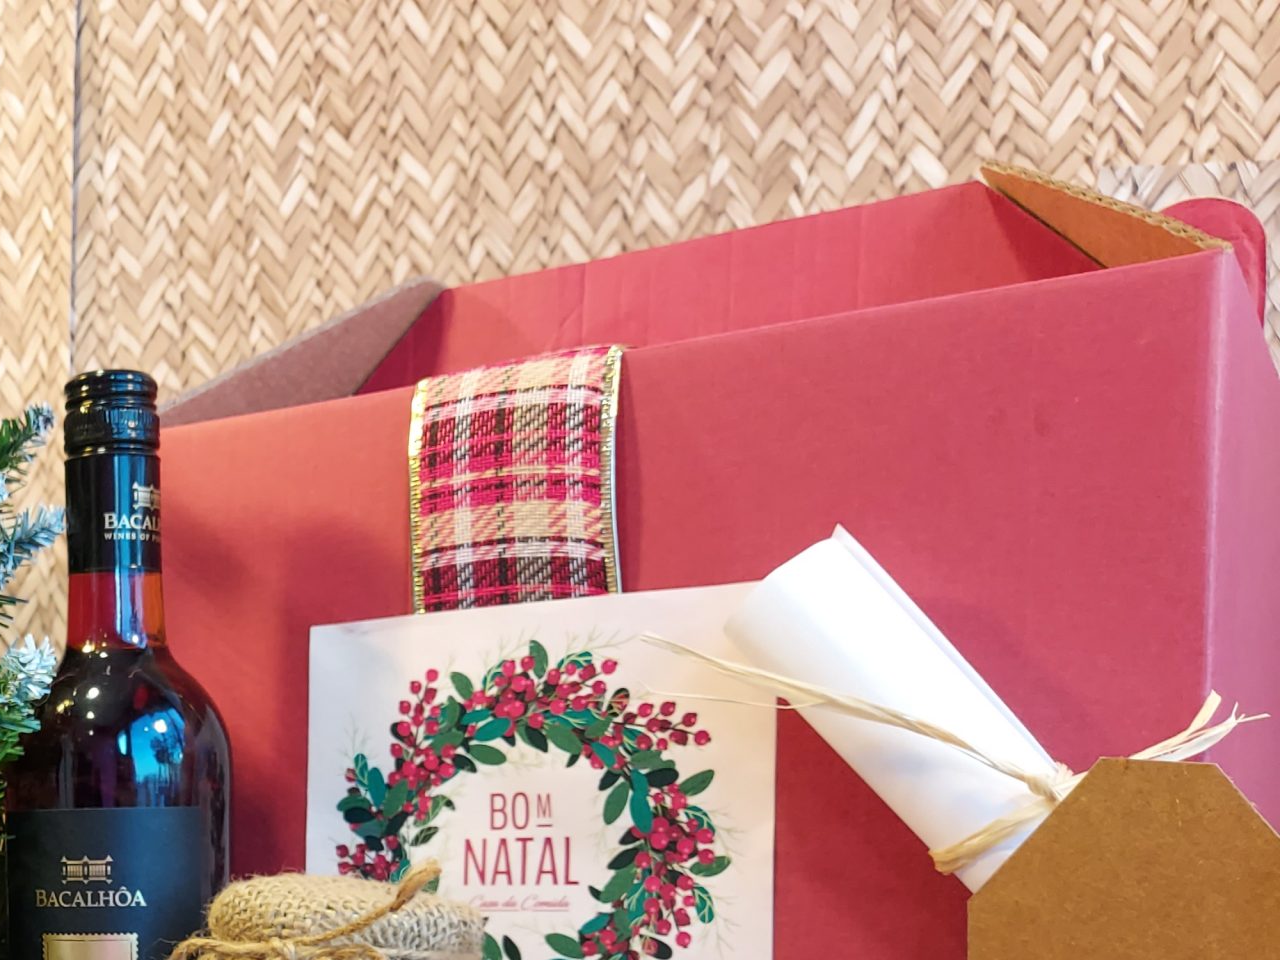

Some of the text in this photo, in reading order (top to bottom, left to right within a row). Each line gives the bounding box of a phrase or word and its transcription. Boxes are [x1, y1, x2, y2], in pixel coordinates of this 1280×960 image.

[104, 531, 136, 541] WINES
[489, 792, 553, 830] BOM
[463, 836, 579, 886] NATAL
[35, 886, 147, 907] BACALHÔA
